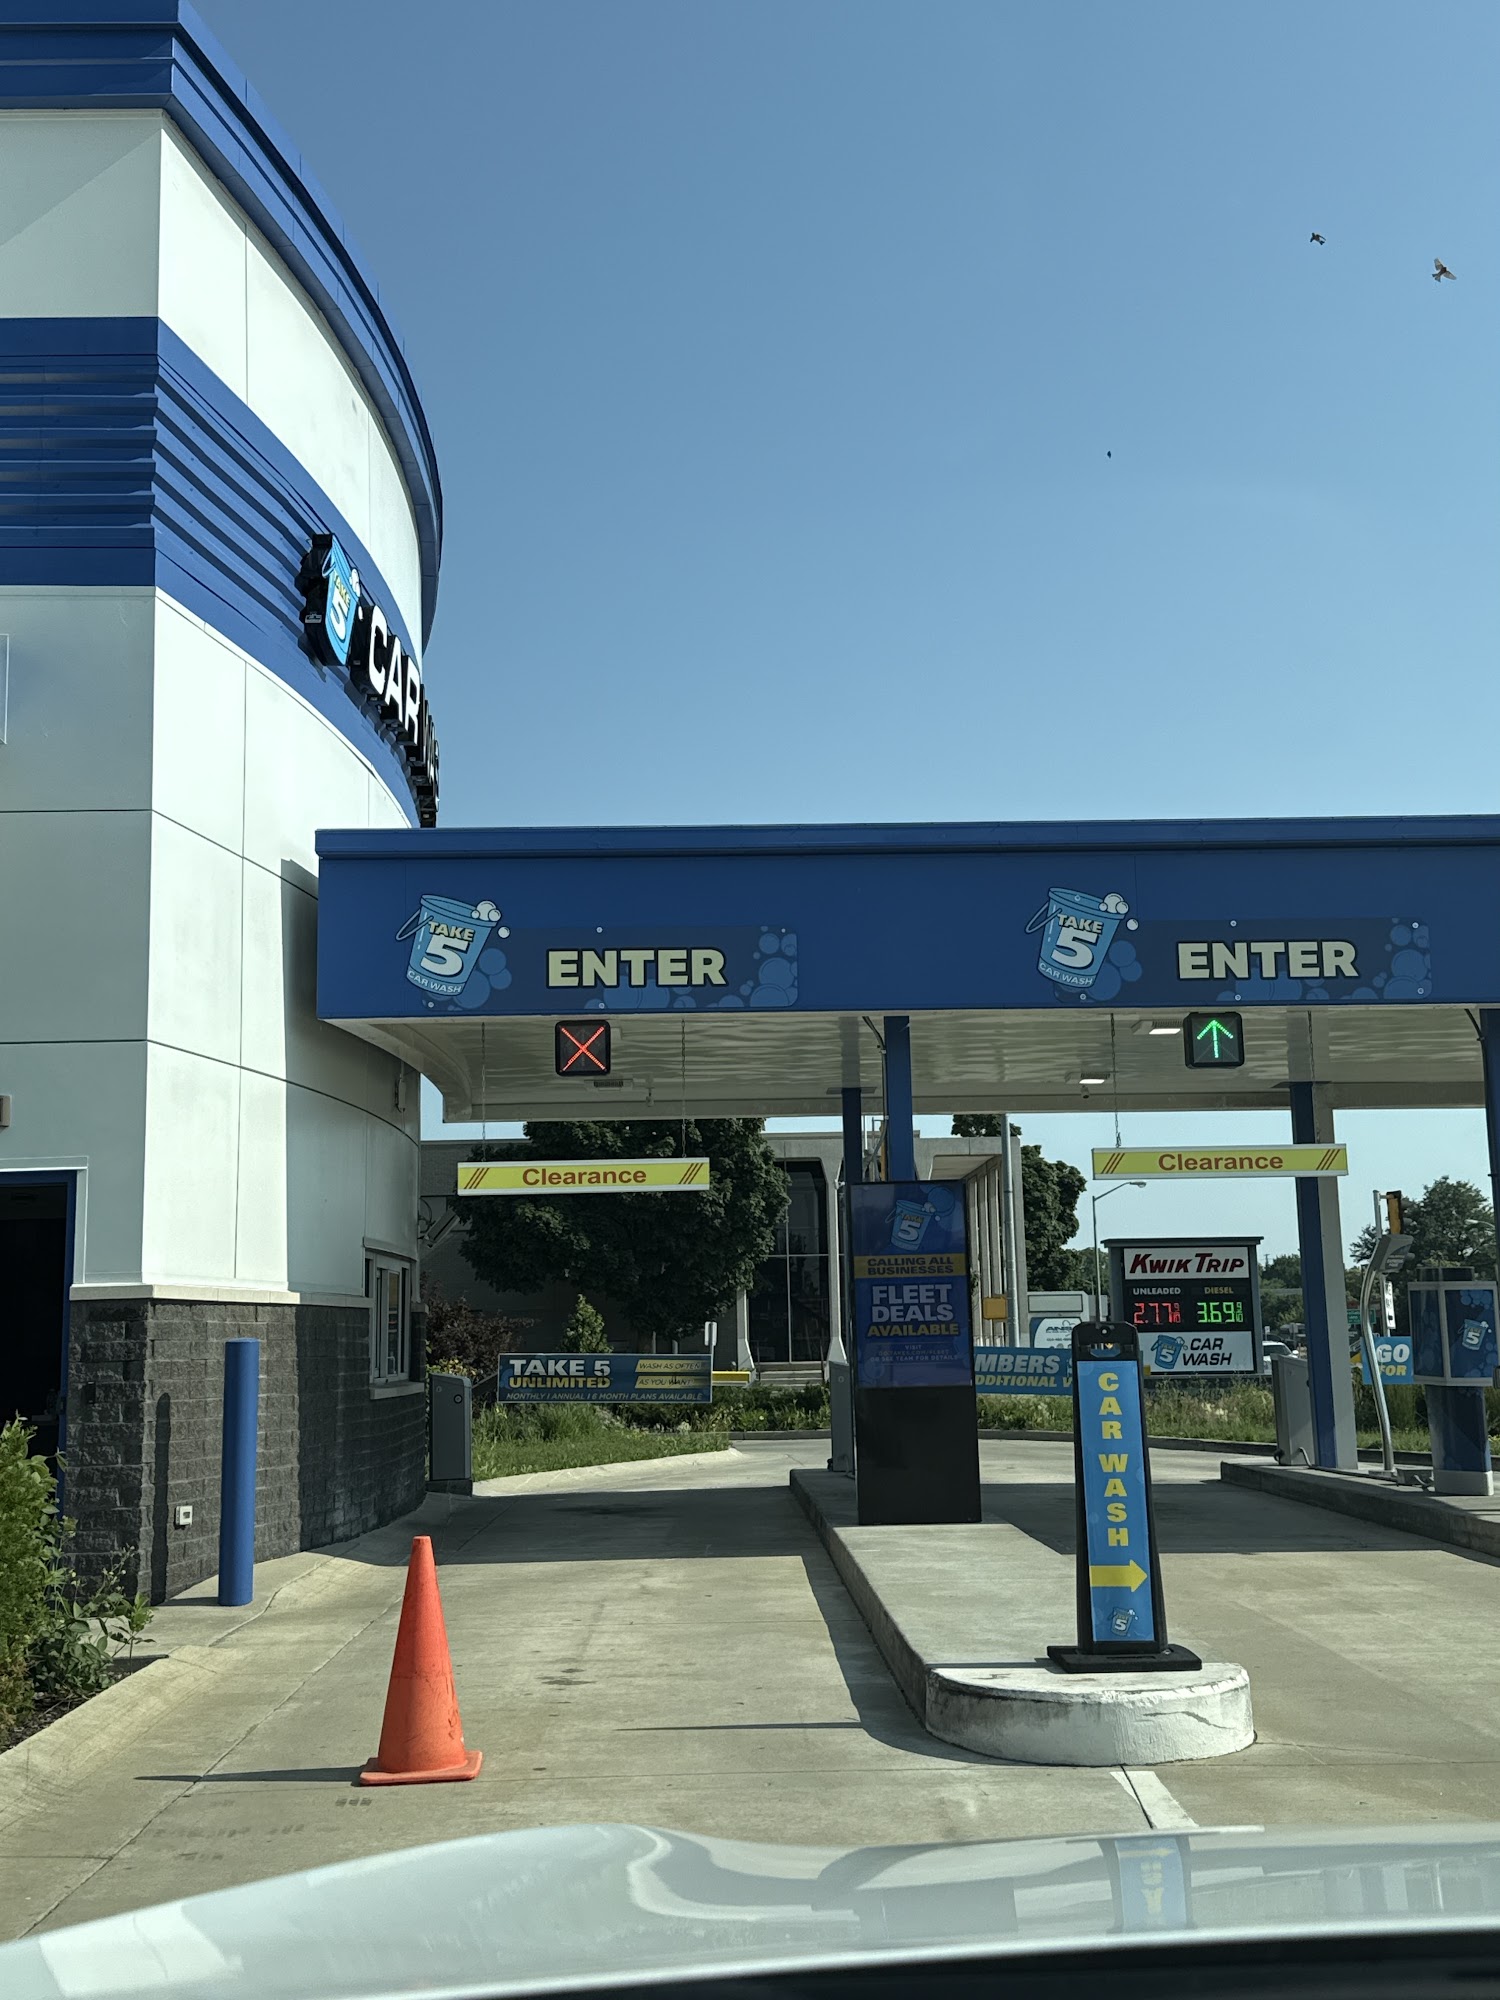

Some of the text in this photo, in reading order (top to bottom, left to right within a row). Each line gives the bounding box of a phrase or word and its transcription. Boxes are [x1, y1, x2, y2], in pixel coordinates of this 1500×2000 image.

[330, 587, 350, 640] 5
[368, 605, 421, 745] CAR
[428, 921, 475, 942] TAKE
[1058, 914, 1103, 934] TAKE
[420, 935, 469, 977] 5
[1050, 927, 1099, 969] 5
[547, 948, 726, 988] ENTER
[1177, 940, 1359, 980] ENTER
[408, 970, 462, 993] CAR WASH
[1039, 962, 1093, 986] CAR WASH
[1158, 1150, 1284, 1172] Clearance
[522, 1166, 647, 1187] Clearance
[897, 1219, 921, 1241] 5
[867, 1256, 954, 1267] CALLING ALL
[867, 1265, 954, 1275] BUSINESSES
[872, 1284, 952, 1305] FLEET
[872, 1304, 954, 1323] DEALS
[1133, 1302, 1173, 1324] 2.77
[1197, 1301, 1235, 1323] 3.69
[867, 1323, 959, 1337] AVAILABLE
[1465, 1331, 1480, 1345] 5
[1190, 1338, 1224, 1350] CAR
[1376, 1343, 1410, 1363] GO
[974, 1353, 1060, 1374] MBERS
[1159, 1348, 1175, 1362] 5
[1183, 1353, 1232, 1366] WASH
[509, 1360, 610, 1376] TAKE 5
[509, 1376, 611, 1389] UNLIMITED
[975, 1374, 1058, 1388] DDITIONAL
[506, 1392, 544, 1400] MONTHLY
[552, 1392, 585, 1400] ANNUAL
[599, 1392, 628, 1400] MONTH
[630, 1392, 657, 1400] PLANS
[658, 1392, 702, 1400] AVAILABLE
[1098, 1372, 1123, 1440] CAR
[1098, 1453, 1129, 1547] WASH
[1114, 1618, 1127, 1631] 5
